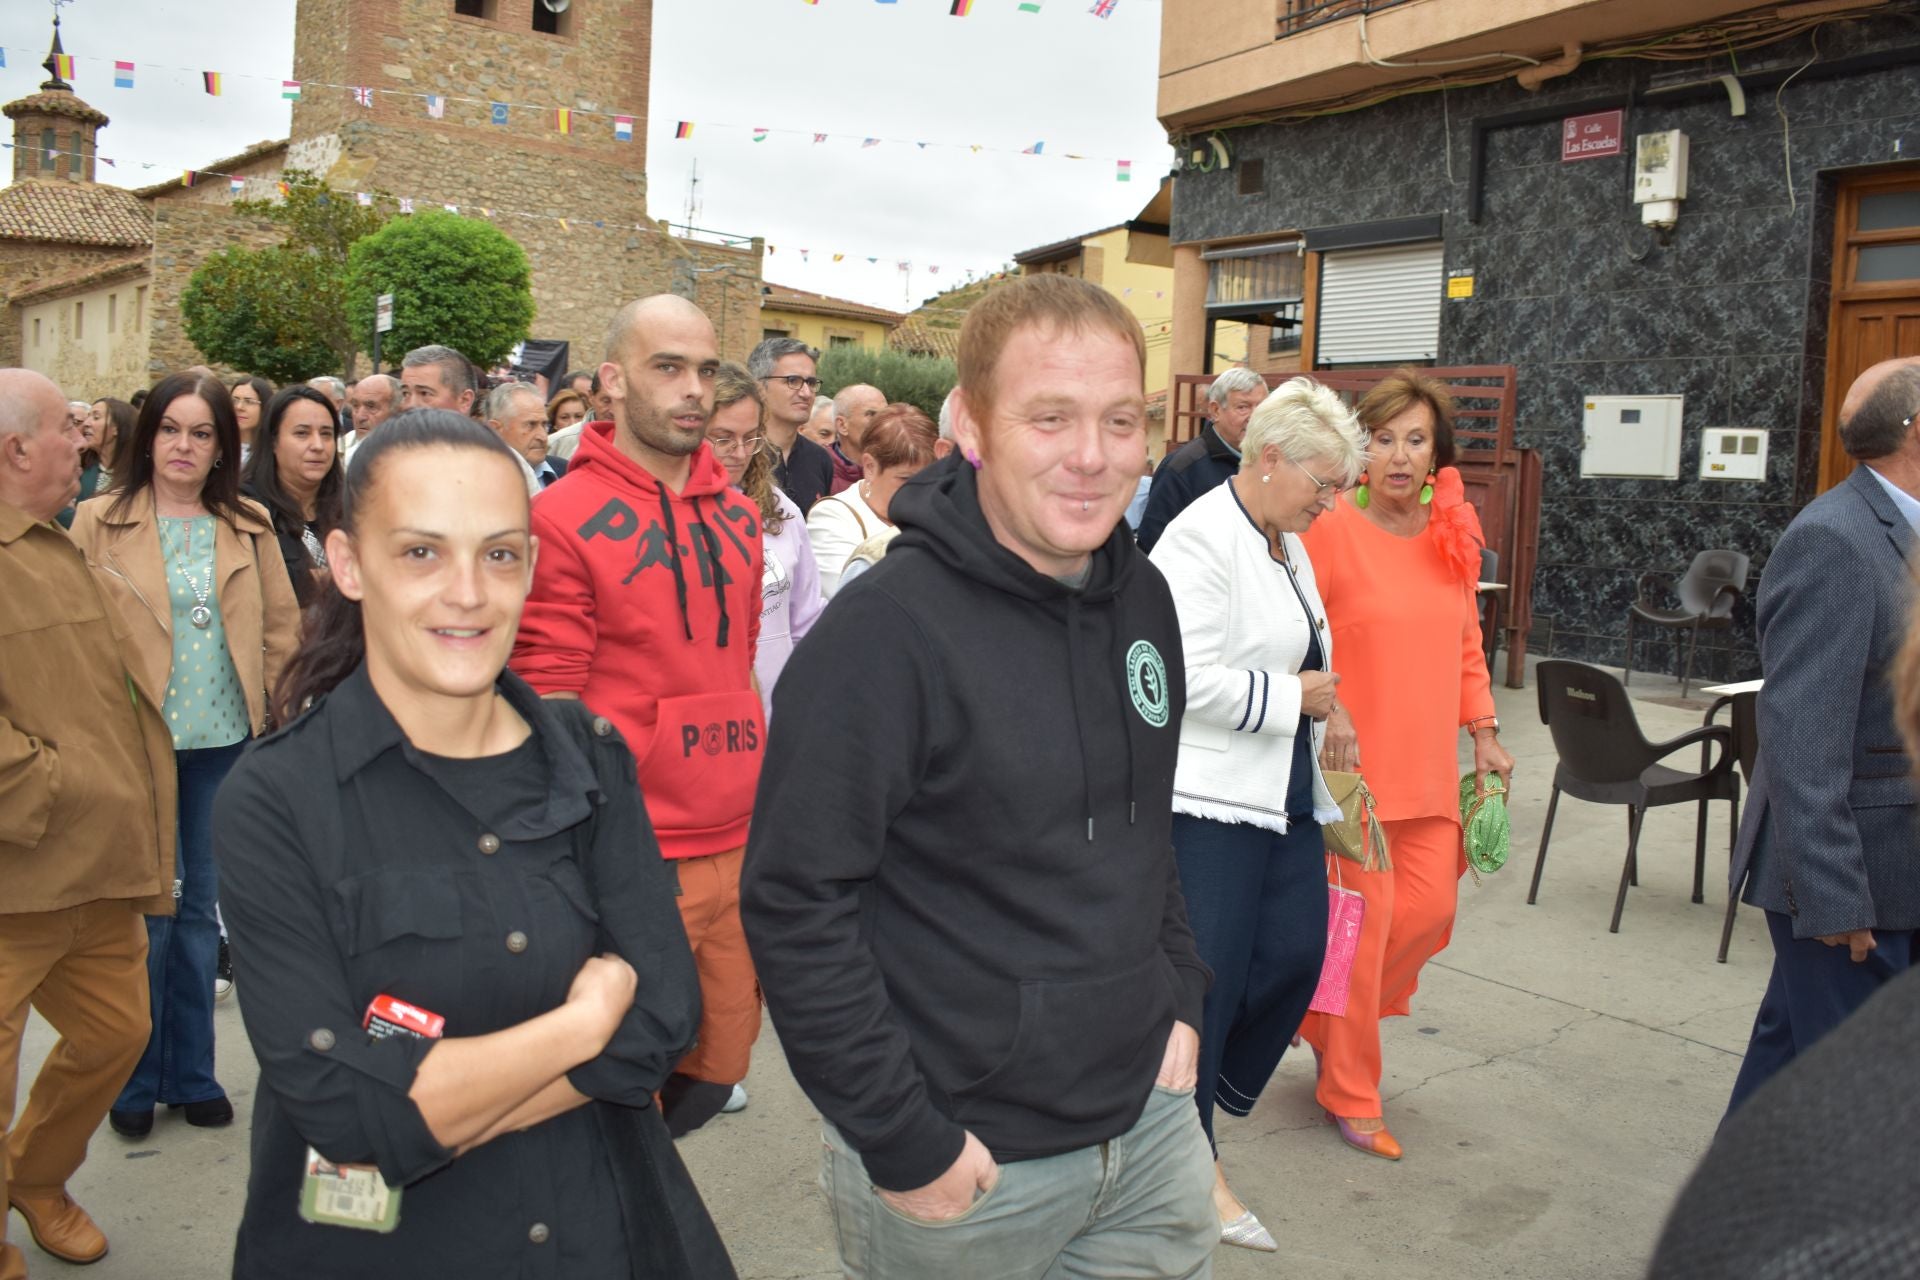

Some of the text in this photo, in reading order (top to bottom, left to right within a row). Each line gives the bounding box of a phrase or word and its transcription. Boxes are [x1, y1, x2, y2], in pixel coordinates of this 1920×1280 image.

[1584, 123, 1602, 134] Calle
[1566, 135, 1617, 154] Las Escuelas
